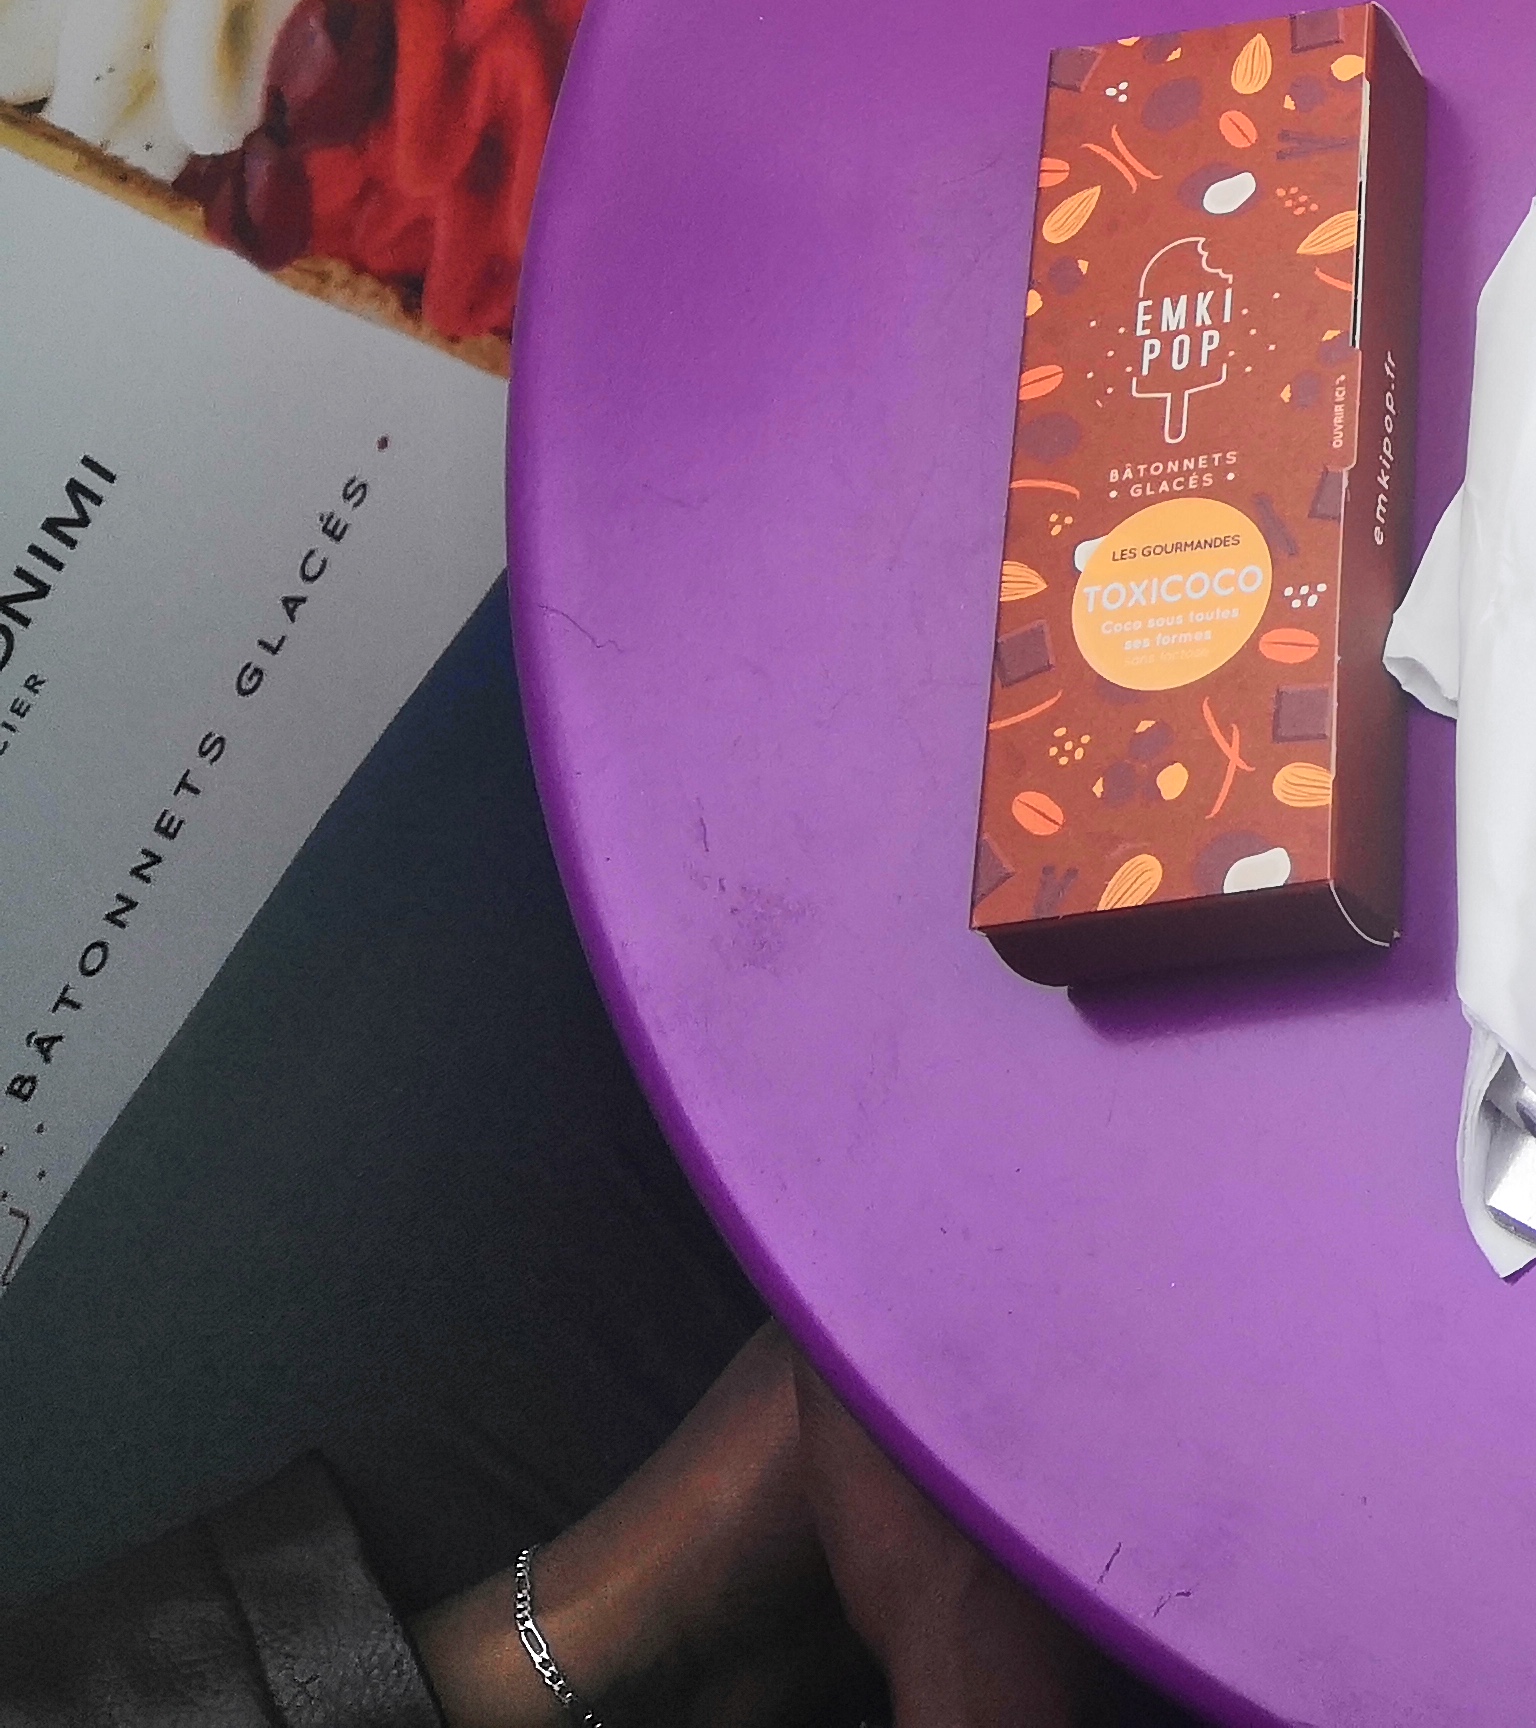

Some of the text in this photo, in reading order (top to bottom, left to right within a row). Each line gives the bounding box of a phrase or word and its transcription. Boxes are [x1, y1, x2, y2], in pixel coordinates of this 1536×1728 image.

[1135, 287, 1233, 337] EMKI
[1141, 329, 1221, 376] POP
[1332, 385, 1347, 448] OUVRIR ICI
[1109, 450, 1238, 483] BÂTONNETS
[1373, 350, 1398, 546] emkipop.fr
[1129, 472, 1214, 498] GLACÉS
[1111, 534, 1241, 562] LES GOURMANDES
[1083, 564, 1264, 614] TOXICOCO
[1101, 607, 1240, 635] Coco sous toutes
[1124, 630, 1212, 651] ses formes
[5, 476, 369, 1102] BÂTONNETS GLACÉS
